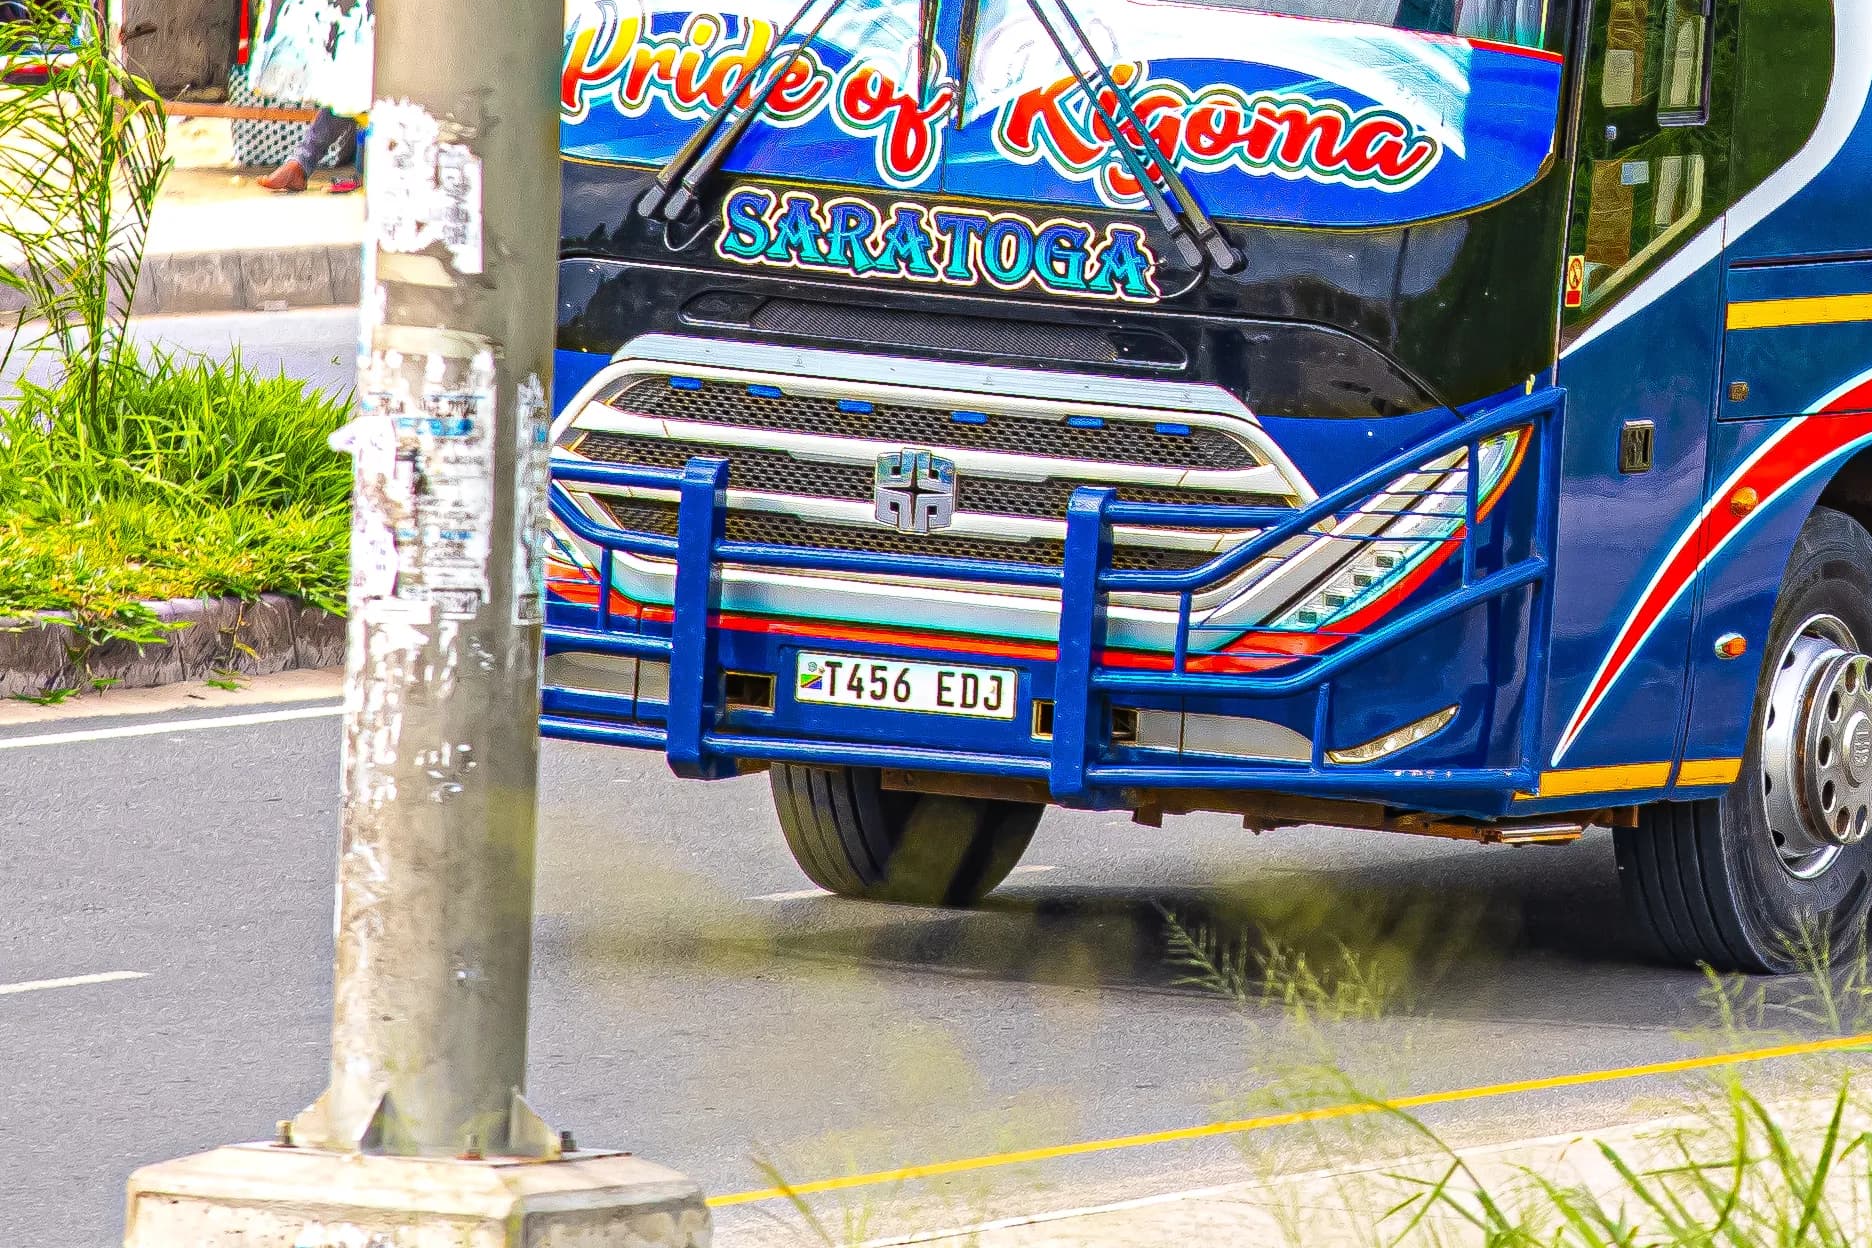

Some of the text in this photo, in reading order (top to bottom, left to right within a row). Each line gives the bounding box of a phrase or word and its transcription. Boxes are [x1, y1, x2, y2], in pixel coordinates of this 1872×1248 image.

[838, 42, 958, 180] of
[995, 35, 1437, 202] Kigoma
[722, 186, 1162, 302] SARATOGA
[824, 660, 1004, 711] T456 EDJ
